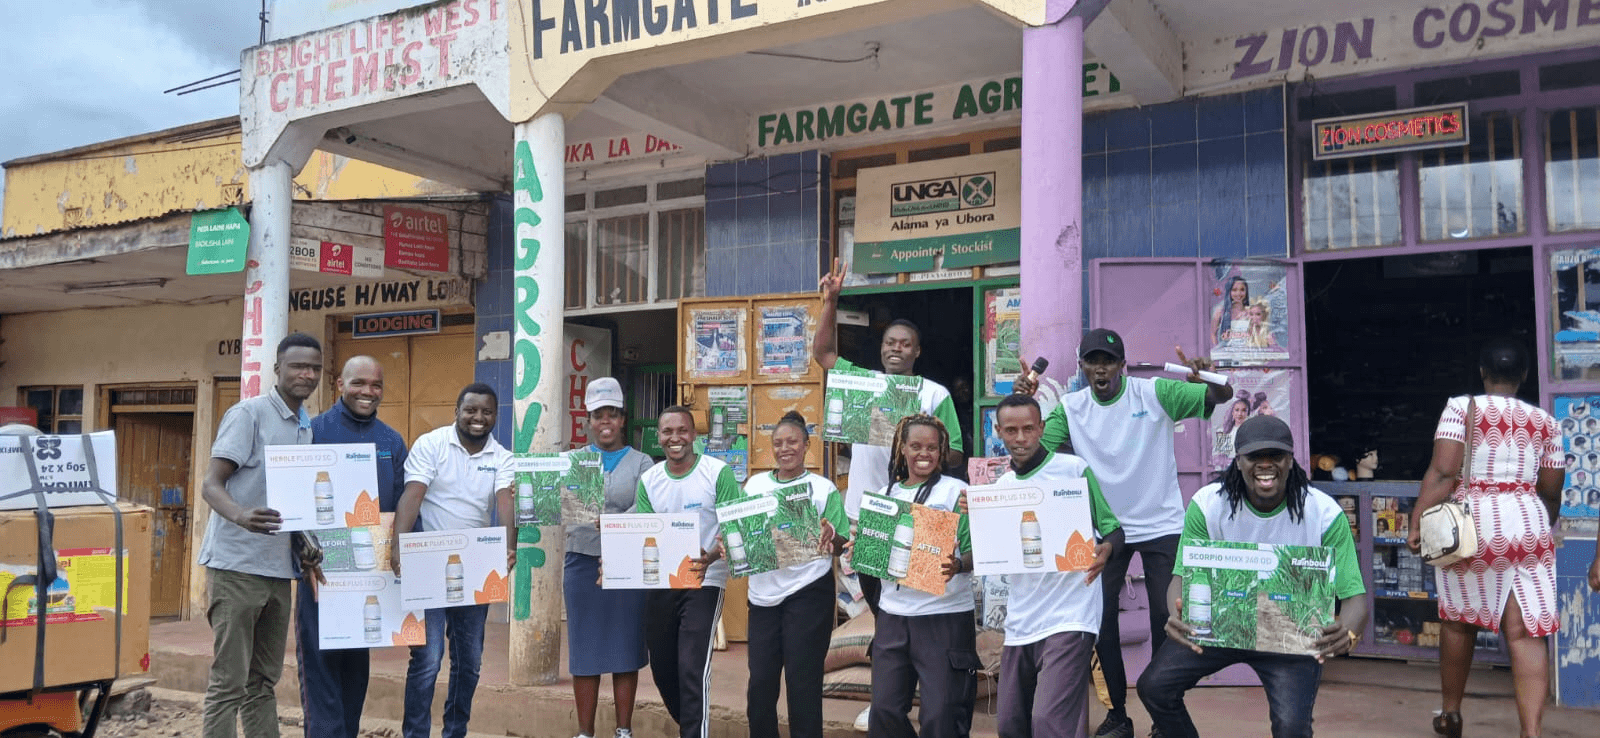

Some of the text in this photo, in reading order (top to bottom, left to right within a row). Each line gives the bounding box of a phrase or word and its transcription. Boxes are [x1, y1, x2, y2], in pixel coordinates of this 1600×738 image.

[1231, 18, 1375, 80] ZION
[270, 35, 457, 112] CHEMIST
[758, 93, 934, 147] FARMGATE
[1322, 113, 1461, 146] ZION COSMETICS
[608, 137, 631, 158] LA
[893, 180, 957, 202] UNGA
[406, 214, 442, 234] airtel
[891, 212, 995, 232] Alama ya Ubora
[289, 246, 316, 258] 2BOB
[890, 239, 993, 262] Appointed Stockist
[326, 257, 345, 269] airtel
[355, 280, 420, 306] H/WAY
[358, 315, 433, 333] LODGING
[569, 339, 588, 450] CHE
[41, 462, 86, 473] 50g X 24
[972, 495, 998, 503] HEROLE
[999, 494, 1017, 502] PLUS
[1053, 489, 1082, 497] Rainbow
[862, 527, 889, 541] BEFORE
[917, 543, 941, 555] AFTER
[1188, 553, 1223, 562] SCORPIO
[1224, 555, 1243, 563] MIXX
[1291, 557, 1327, 567] Rainbow
